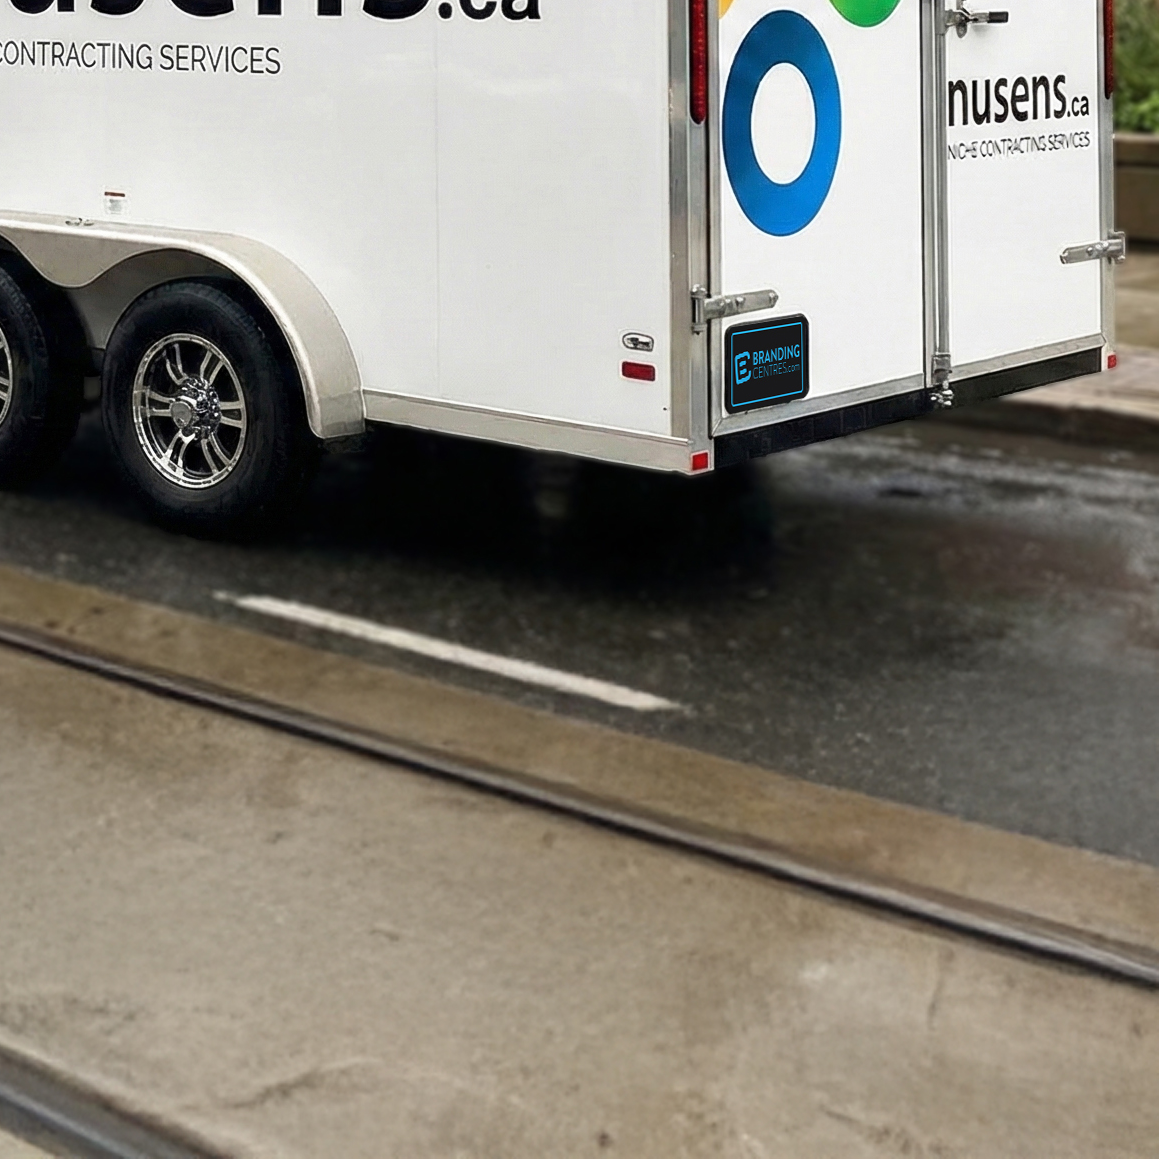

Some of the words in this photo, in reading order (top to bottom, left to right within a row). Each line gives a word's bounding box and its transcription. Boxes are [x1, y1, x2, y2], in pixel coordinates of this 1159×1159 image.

[159, 43, 282, 75] SERVICES
[948, 74, 1090, 127] nusens.ca
[752, 343, 801, 366] BRANDING
